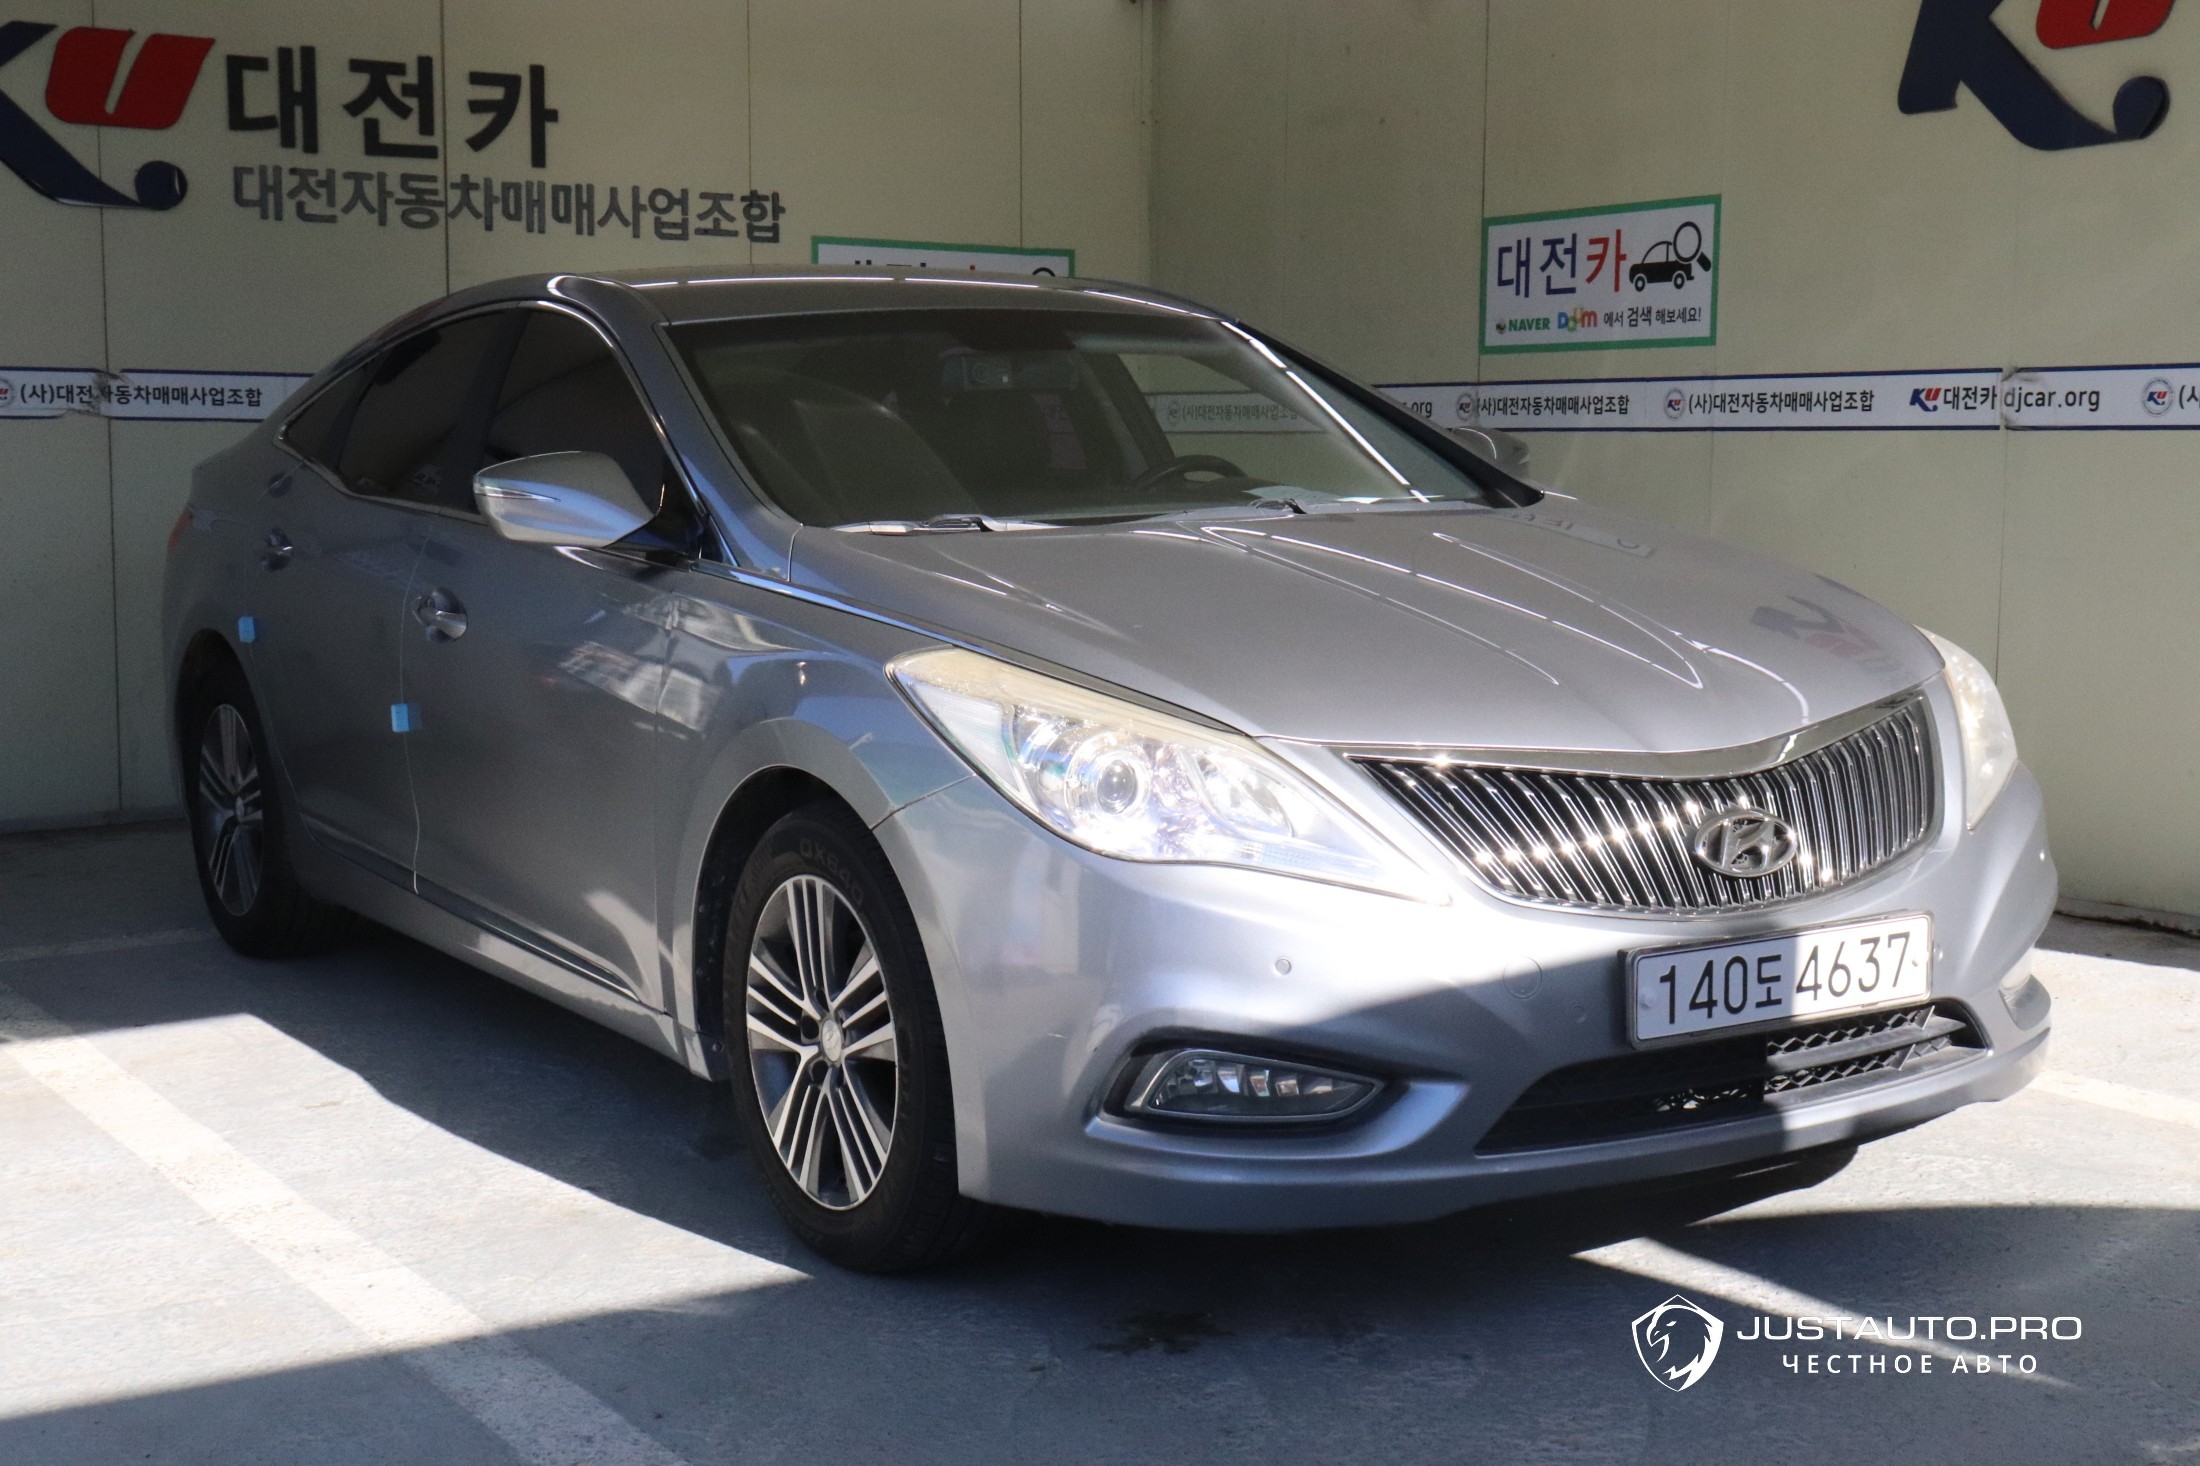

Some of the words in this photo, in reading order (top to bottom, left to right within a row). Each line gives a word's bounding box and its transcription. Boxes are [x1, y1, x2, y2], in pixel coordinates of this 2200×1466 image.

[225, 45, 559, 169] 대전카
[232, 163, 786, 244] 대전자동차매매사업조합
[1496, 228, 1628, 298] 대전카
[1508, 317, 1550, 332] NAVER
[1603, 311, 1624, 327] 에서
[1627, 306, 1652, 327] 검색
[1655, 306, 1702, 325] 해보세요!
[1476, 395, 1629, 416] (사)대전자동차매매사업조합
[1688, 390, 1875, 413] (사)대전자동차매매사업조합
[1943, 385, 1998, 411] 대전카
[2003, 387, 2100, 412] djcar.org
[1658, 953, 1784, 1026] 140도
[1795, 931, 1912, 1002] 4637
